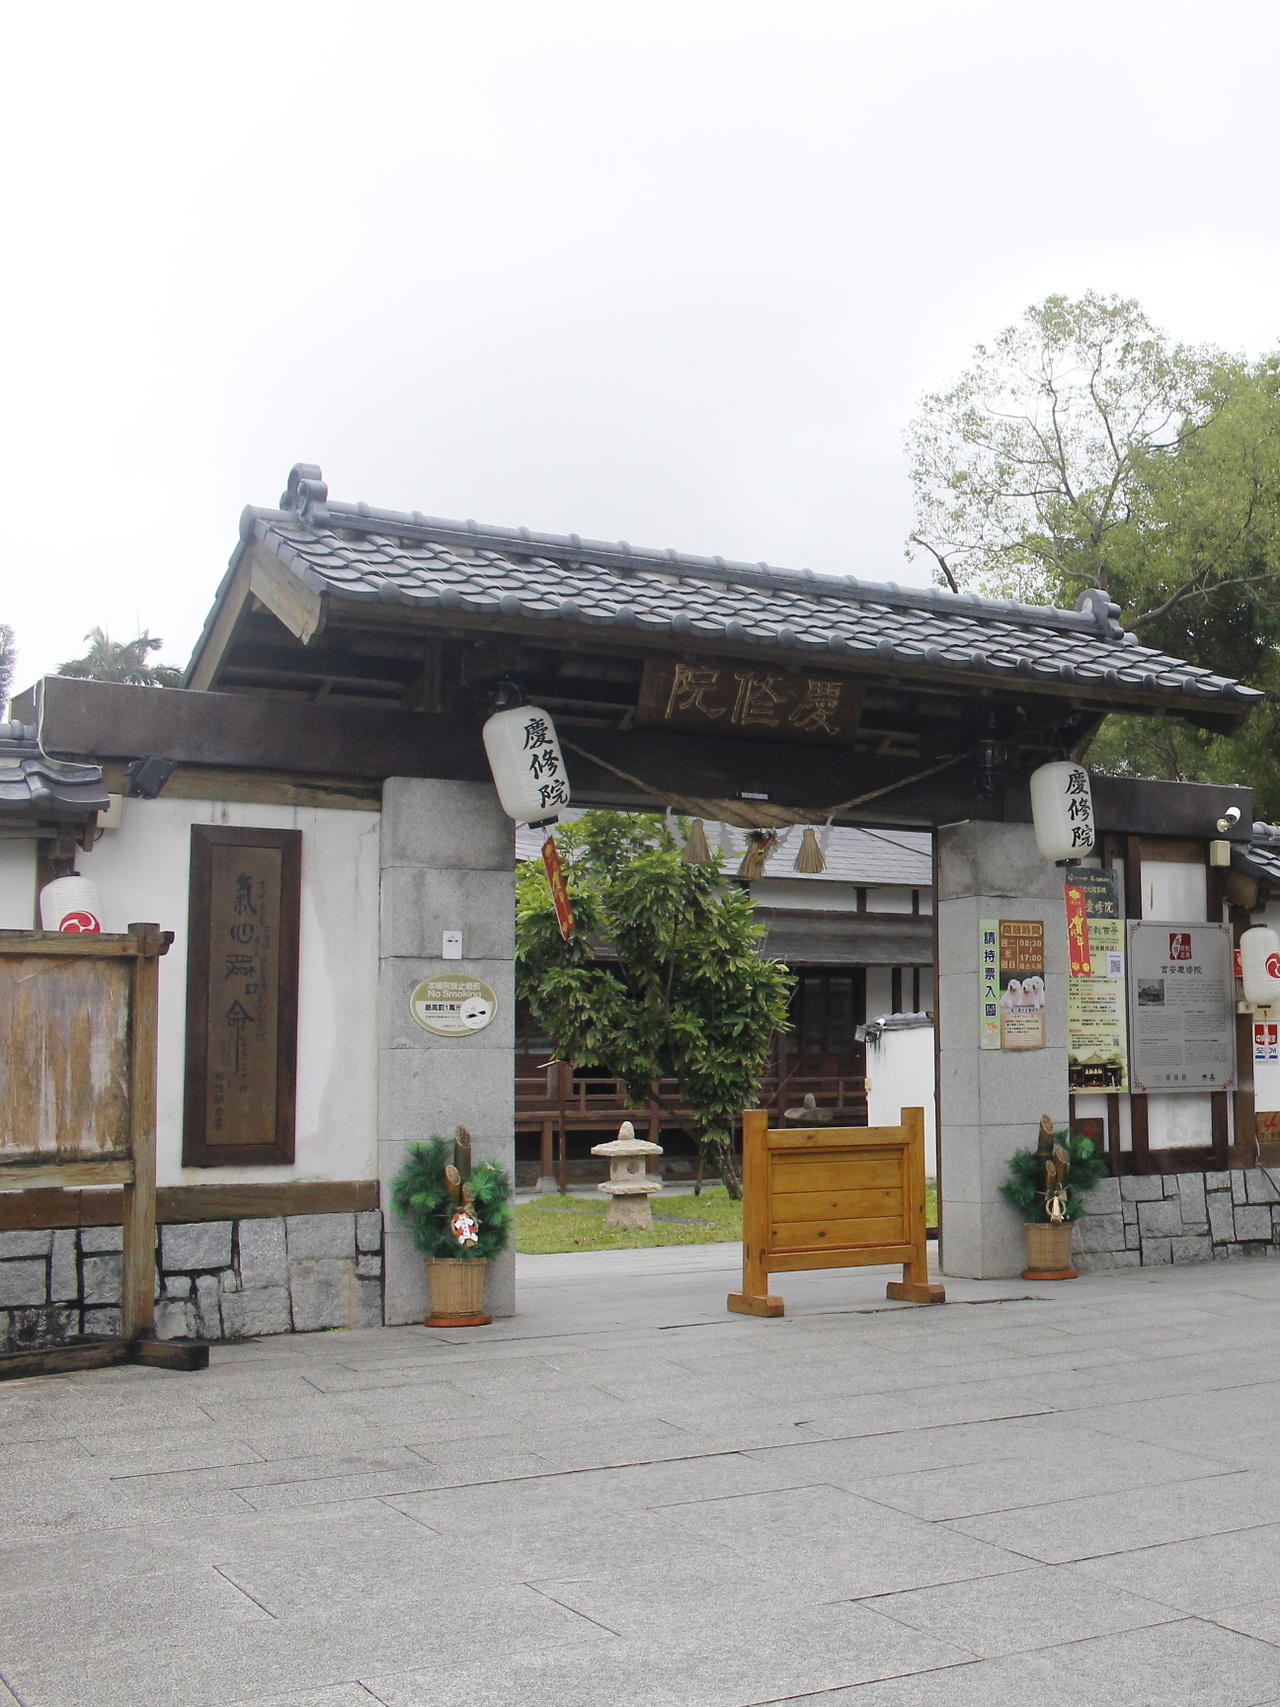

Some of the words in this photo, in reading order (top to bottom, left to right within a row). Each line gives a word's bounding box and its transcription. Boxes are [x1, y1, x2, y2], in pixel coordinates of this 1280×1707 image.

[664, 662, 844, 736] 慶修院
[522, 717, 569, 809] 慶修院
[1065, 768, 1094, 848] 慶修院
[1019, 939, 1042, 947] 08:30
[1020, 954, 1042, 962] 17:00
[984, 931, 997, 1017] 請持票入園
[1160, 965, 1203, 975] 吉安慶修院
[427, 990, 441, 998] No
[442, 990, 482, 998] Smoking
